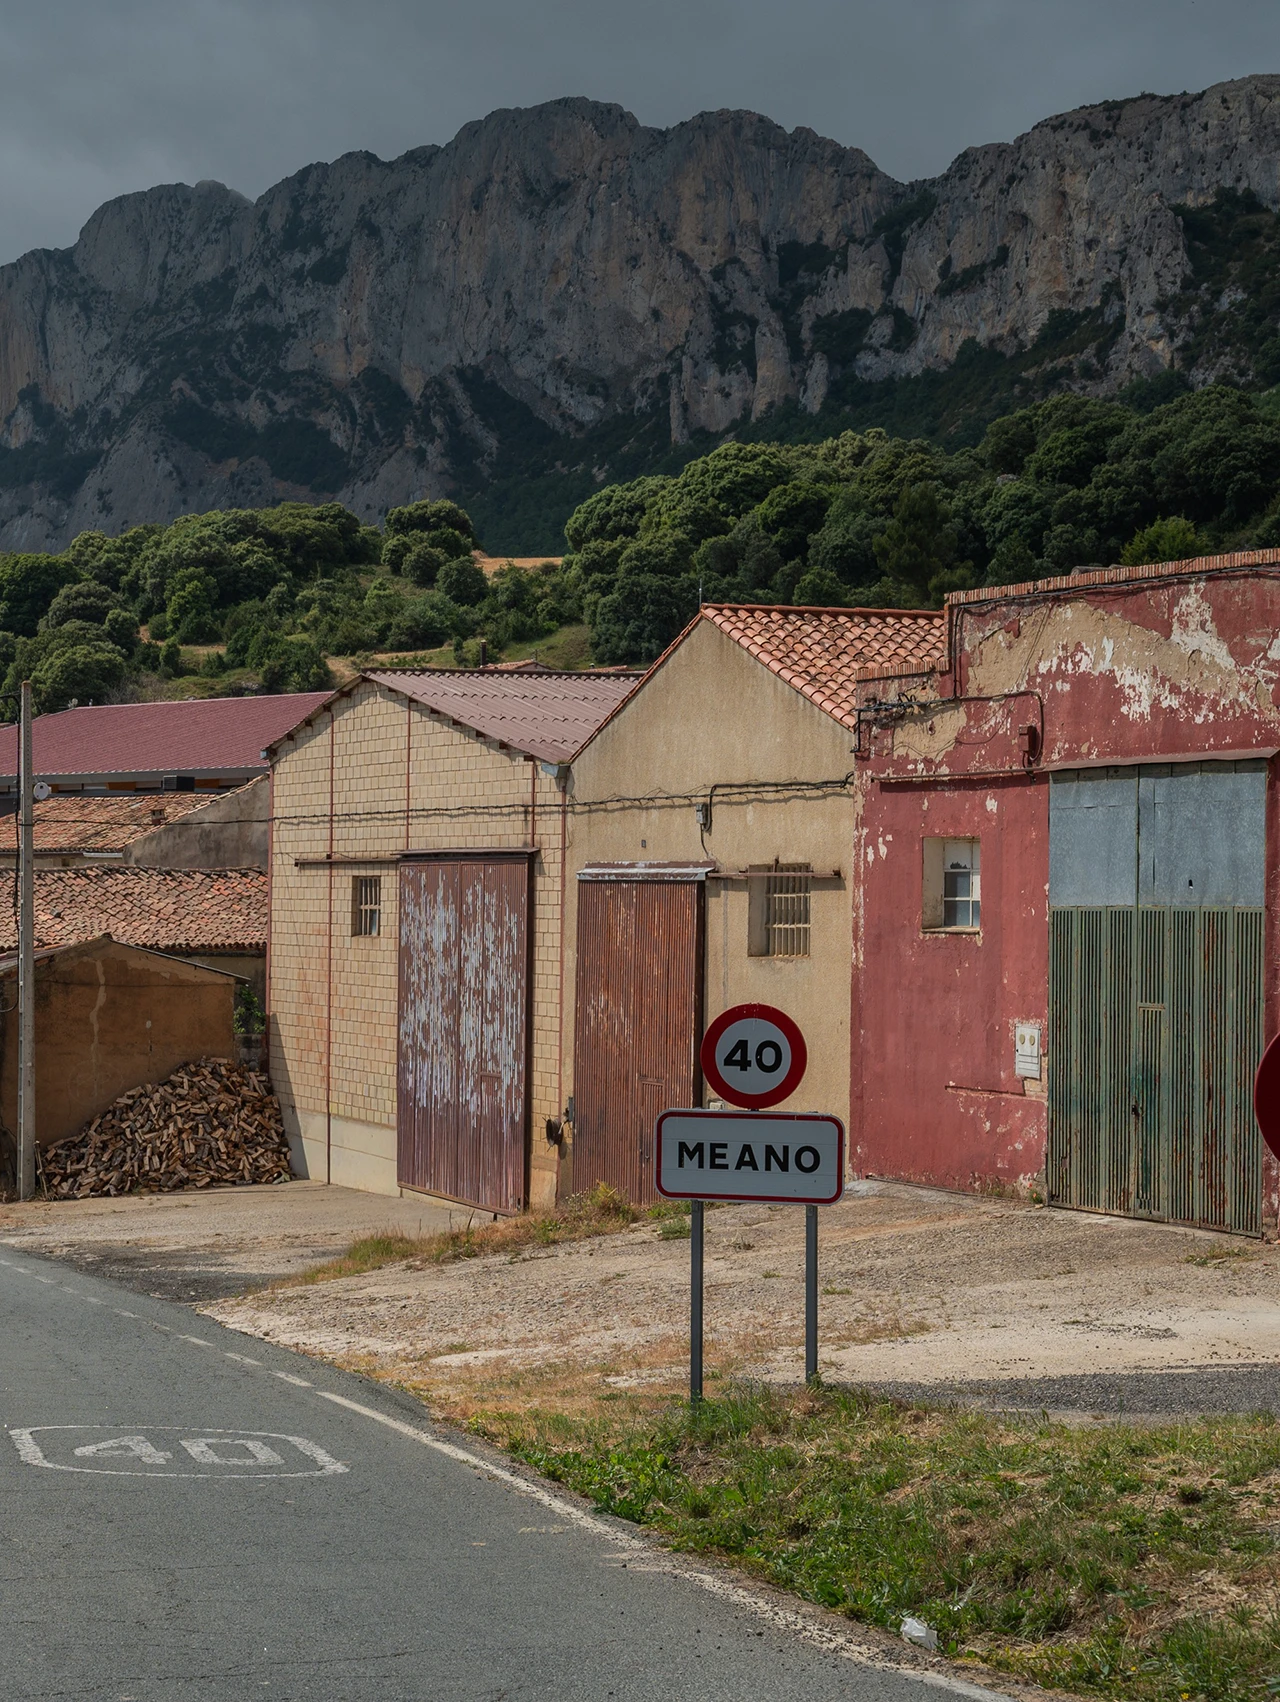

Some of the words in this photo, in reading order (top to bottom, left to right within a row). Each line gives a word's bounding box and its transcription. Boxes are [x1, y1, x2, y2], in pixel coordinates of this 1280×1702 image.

[723, 1039, 783, 1074] 40
[678, 1141, 821, 1174] MEANO
[73, 1434, 285, 1467] 40
